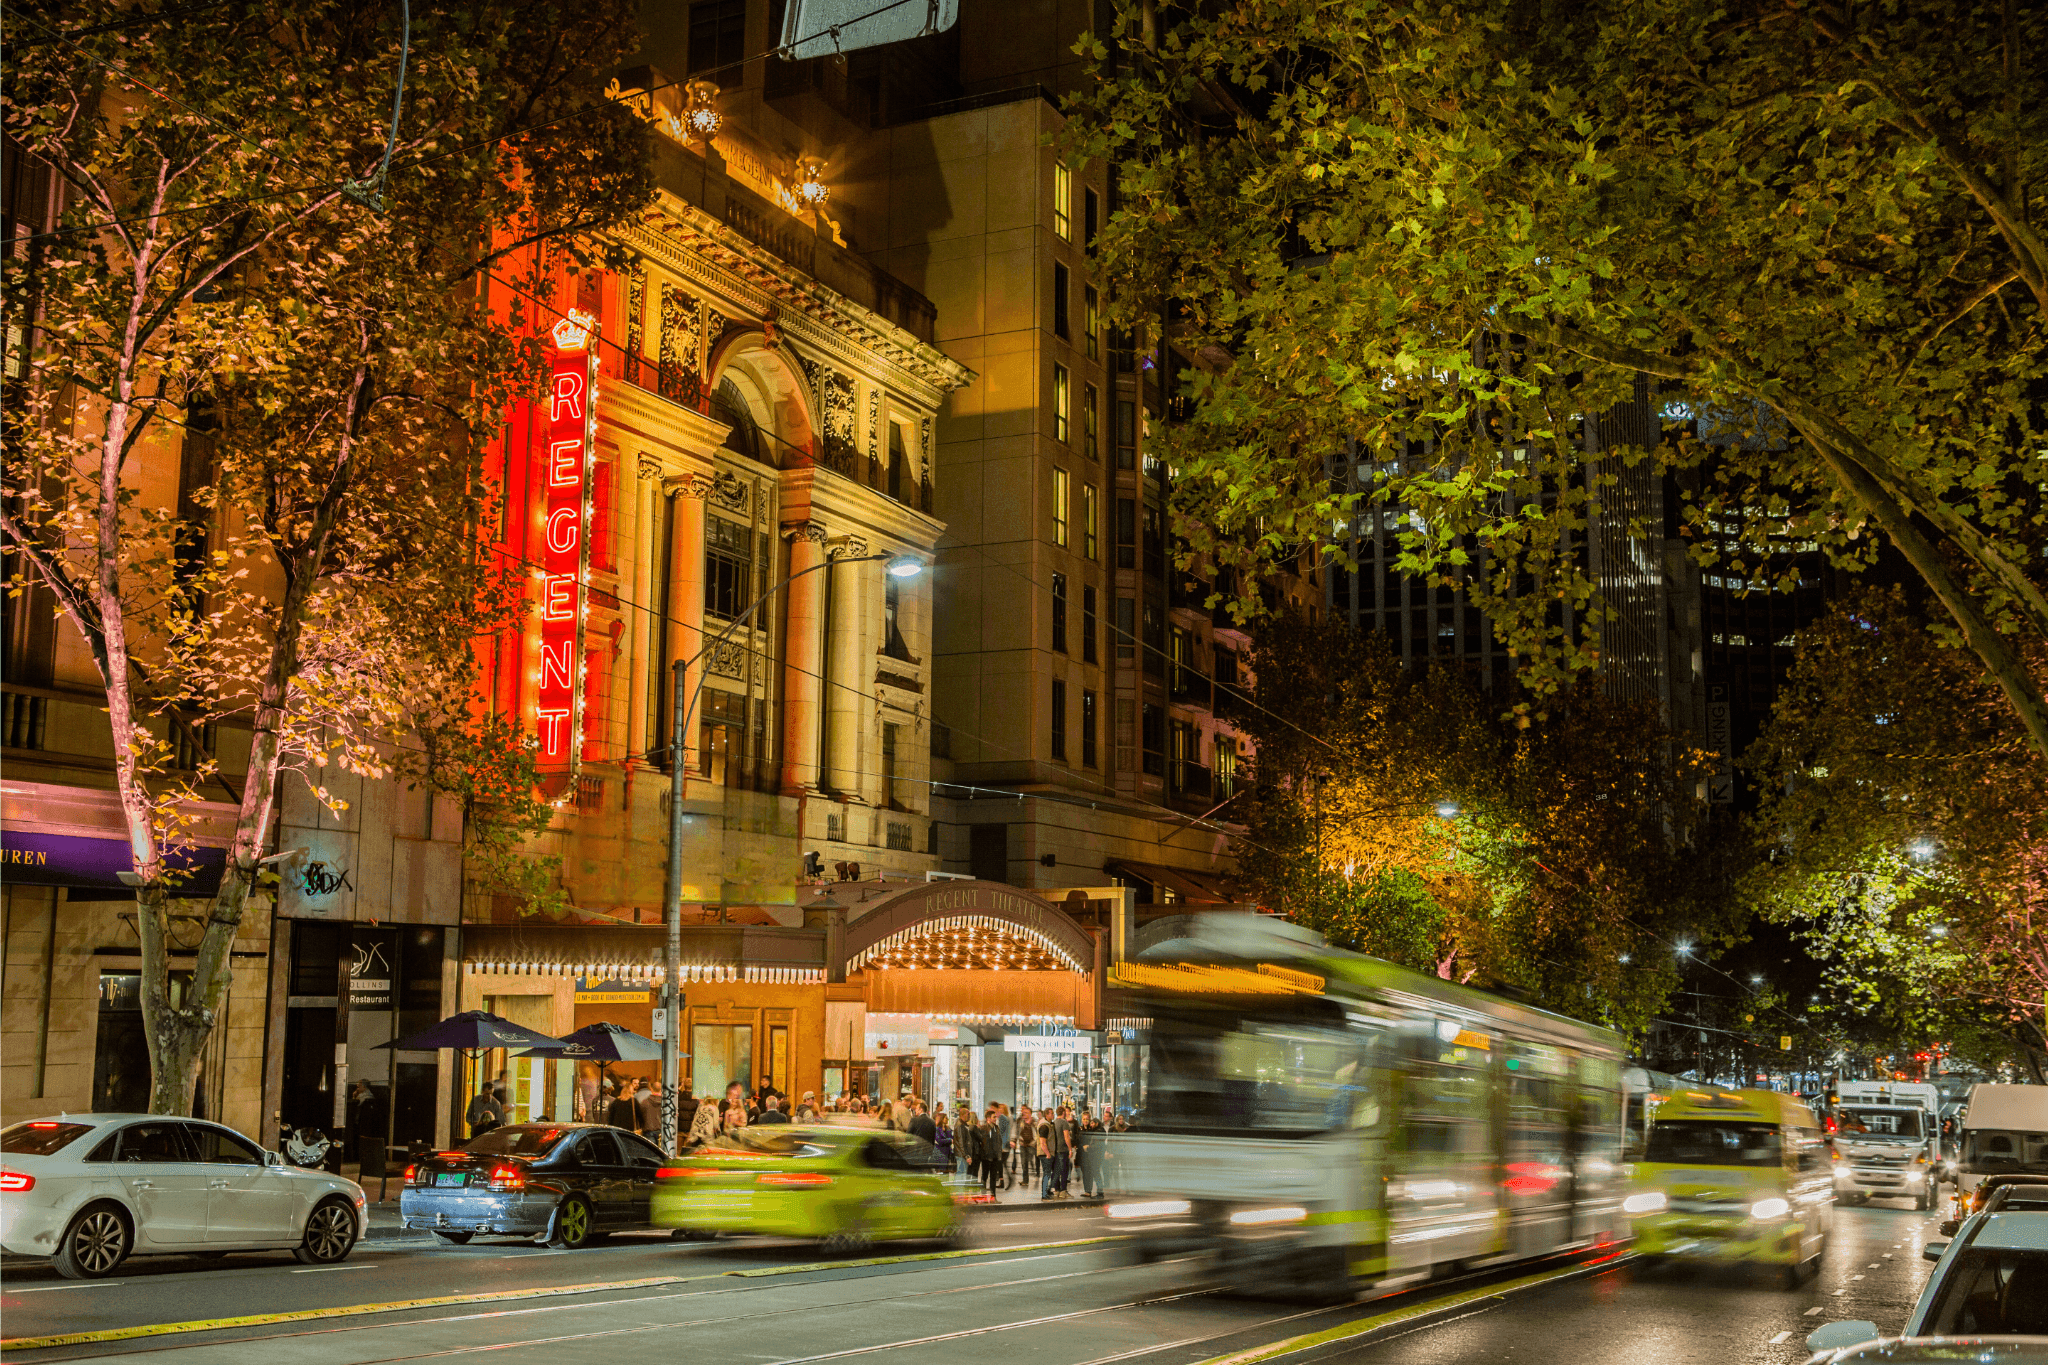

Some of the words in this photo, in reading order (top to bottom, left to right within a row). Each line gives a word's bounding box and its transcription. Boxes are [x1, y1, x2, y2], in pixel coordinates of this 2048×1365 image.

[538, 372, 583, 756] REGENT
[1711, 686, 1724, 702] P
[1712, 706, 1727, 776] PARKING
[1595, 793, 1608, 801] 38
[0, 849, 47, 865] UREN
[925, 889, 979, 914] REGENT
[990, 891, 1045, 923] THEATRE
[350, 994, 390, 1004] Restaurant
